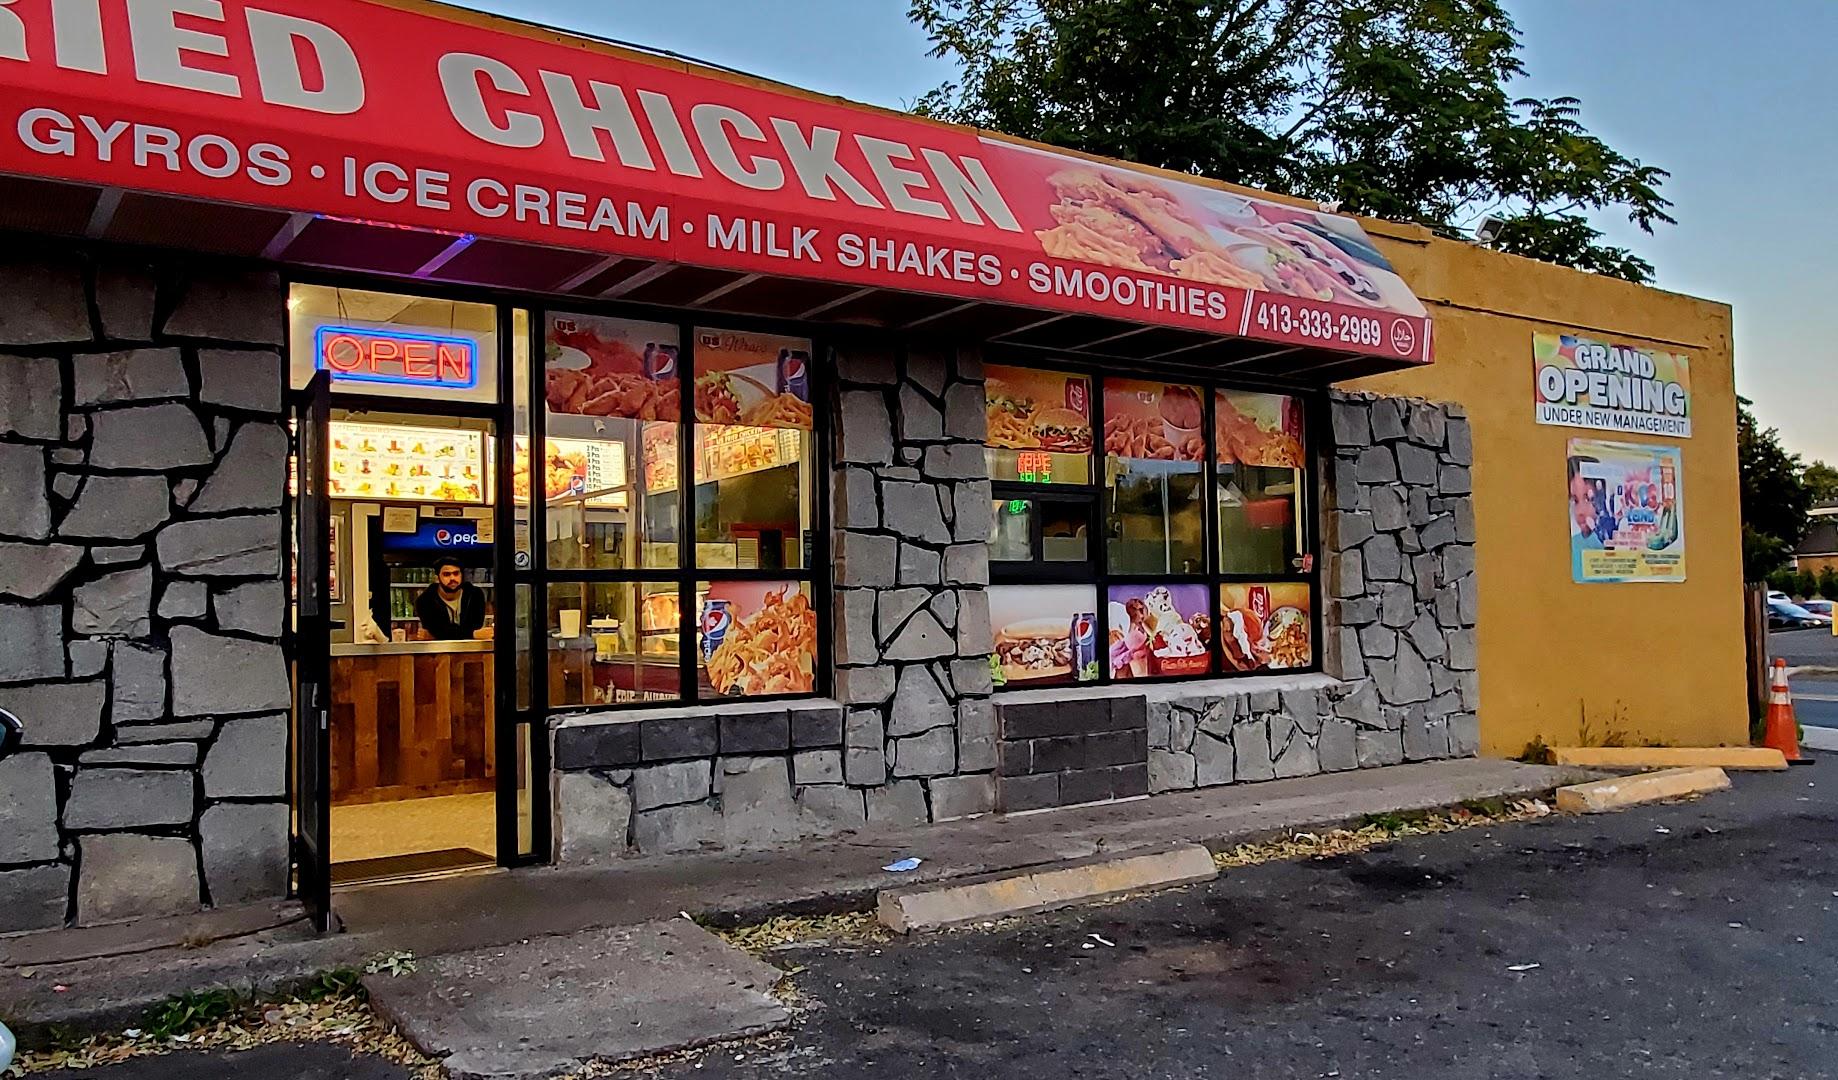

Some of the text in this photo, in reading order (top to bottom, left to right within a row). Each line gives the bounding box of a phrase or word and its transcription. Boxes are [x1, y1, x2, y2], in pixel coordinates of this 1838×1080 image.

[437, 52, 1022, 233] CHICKEN
[17, 108, 1227, 319] GYROS ICE CREAM MILK SHAKES SMOOTHIES
[1257, 302, 1382, 347] 413-333-2989
[326, 335, 468, 379] OPEN
[1574, 344, 1655, 380] GRAND
[1538, 365, 1686, 417] OPENING
[1543, 406, 1686, 434] UNDER NEW MANAGEMENT
[453, 533, 478, 545] pep
